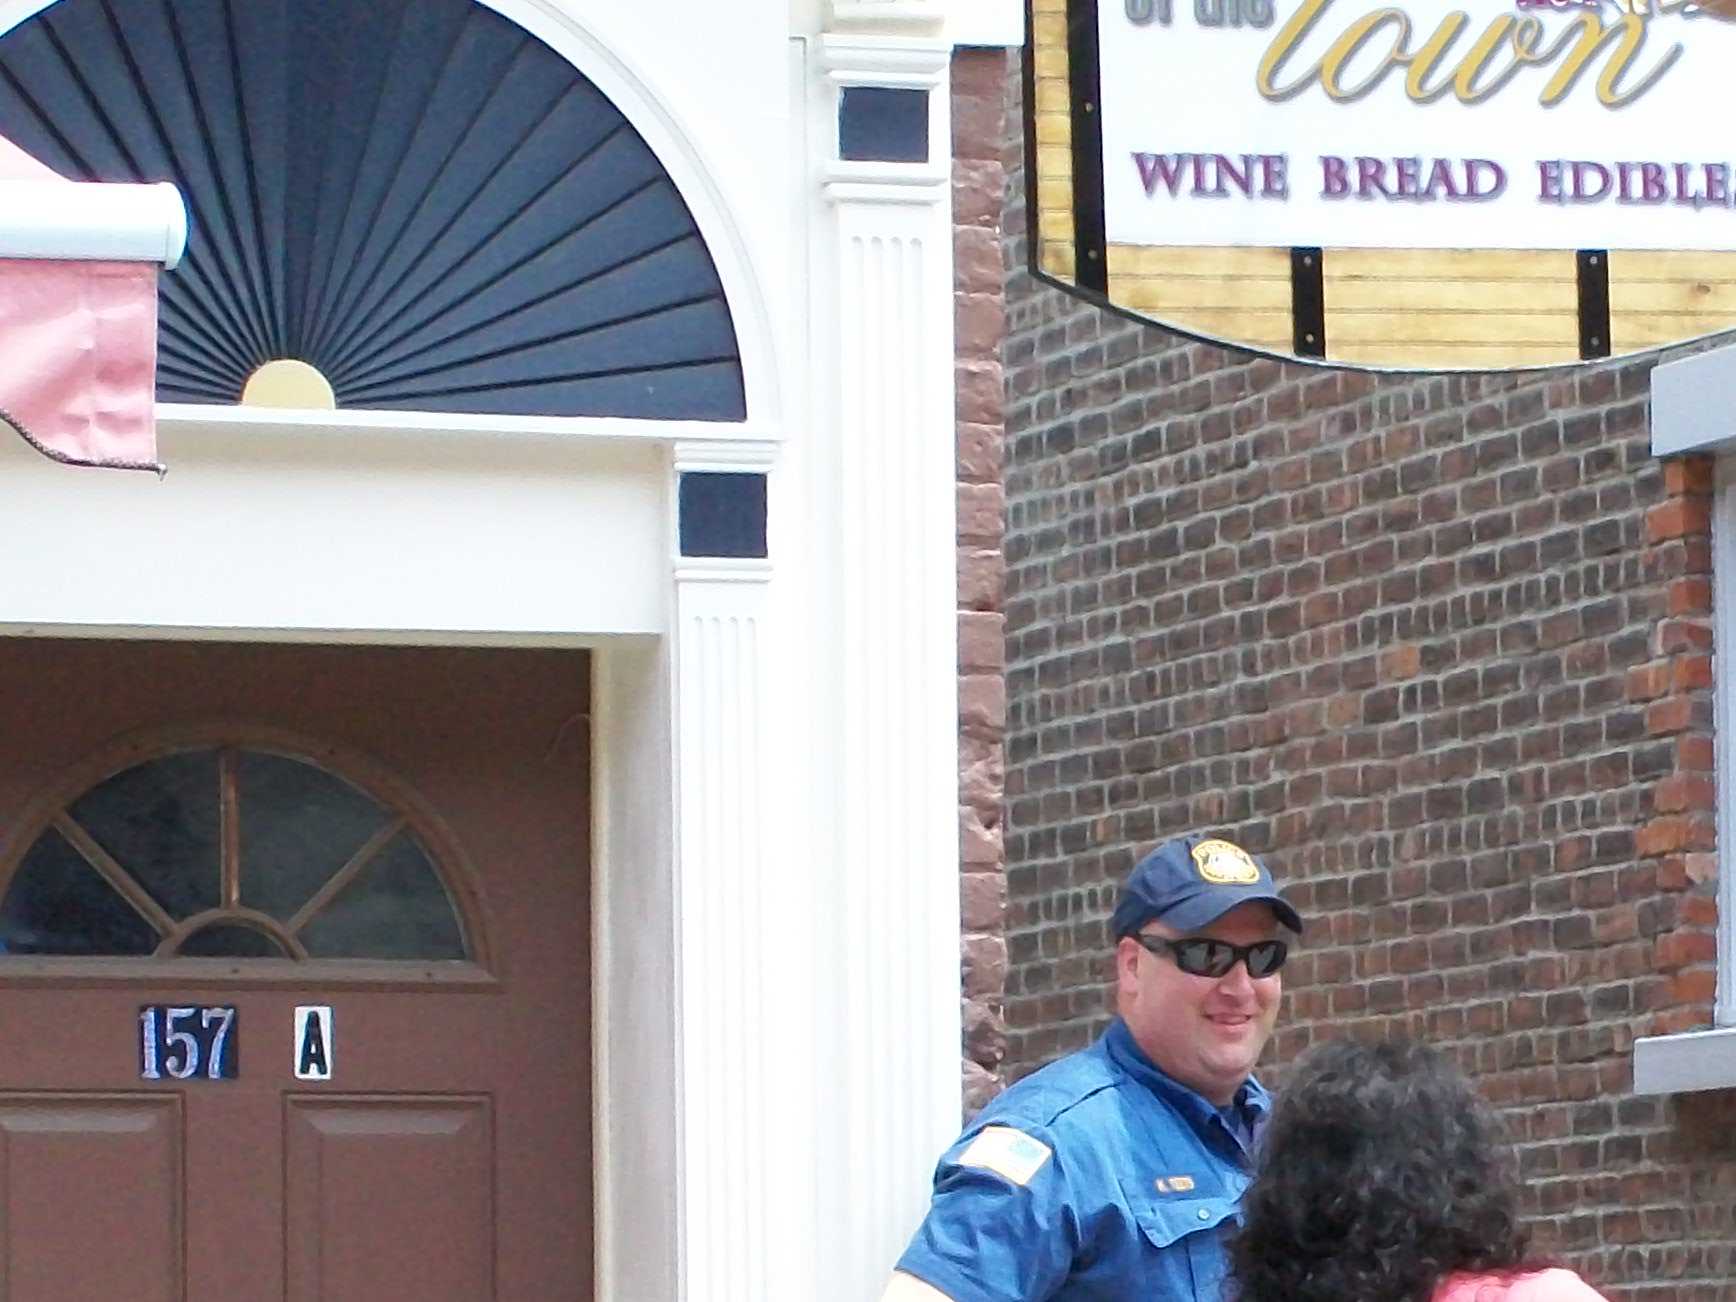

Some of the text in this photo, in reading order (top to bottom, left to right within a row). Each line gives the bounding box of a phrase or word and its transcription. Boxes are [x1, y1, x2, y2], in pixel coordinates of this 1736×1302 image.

[1131, 150, 1289, 201] WINE
[1318, 155, 1508, 203] BREAD
[140, 1007, 234, 1079] 157
[299, 1011, 328, 1075] A
